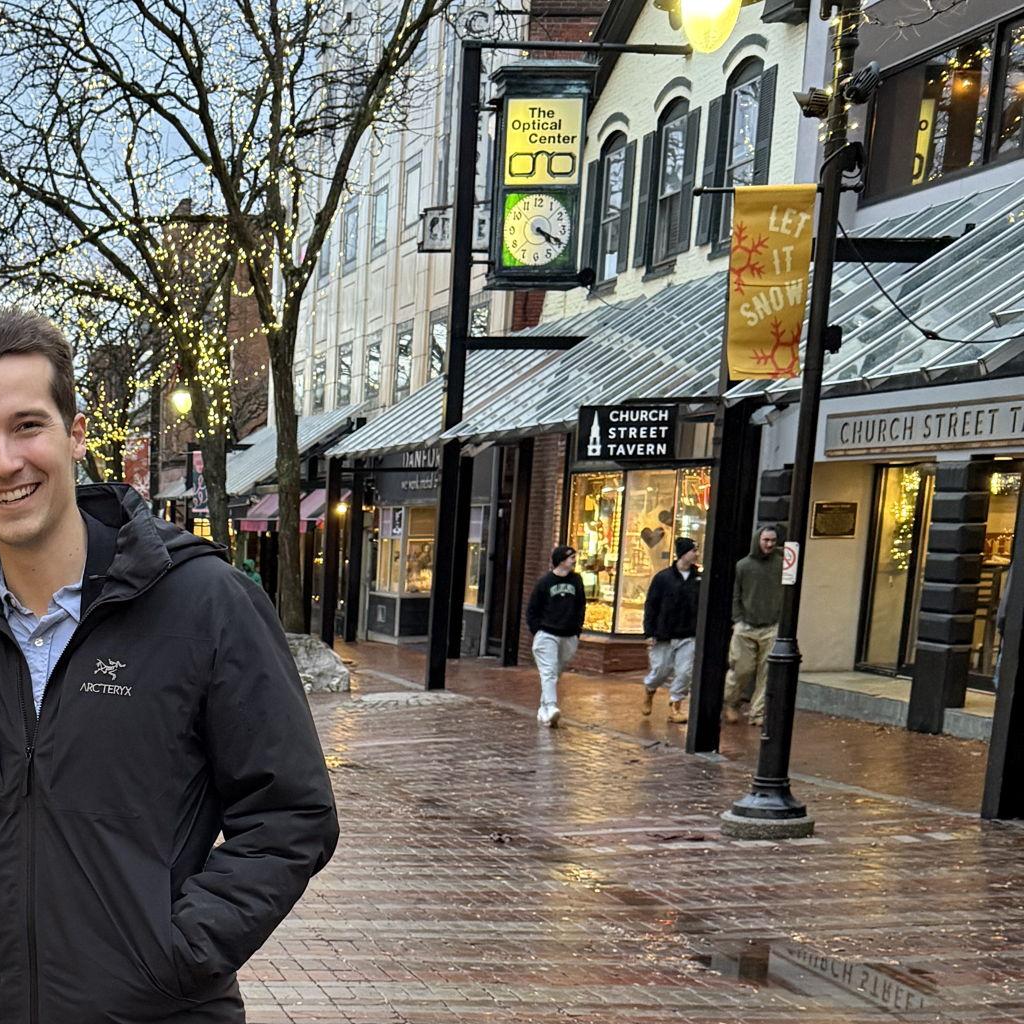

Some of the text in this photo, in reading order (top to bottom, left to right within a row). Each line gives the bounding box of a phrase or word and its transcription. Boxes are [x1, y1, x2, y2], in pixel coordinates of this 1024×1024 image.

[529, 107, 555, 118] The
[512, 119, 562, 133] Optical
[528, 133, 577, 144] Center
[523, 201, 530, 211] 11
[534, 198, 544, 208] 12
[557, 211, 564, 222] 2
[769, 205, 812, 239] LET
[560, 224, 567, 235] 3
[772, 245, 794, 275] IT
[740, 278, 804, 327] SNOW
[609, 409, 668, 422] CHURCH
[608, 426, 668, 439] STREET
[840, 416, 915, 445] CHURCH
[923, 408, 1000, 439] STREET
[607, 443, 667, 456] TAVERN
